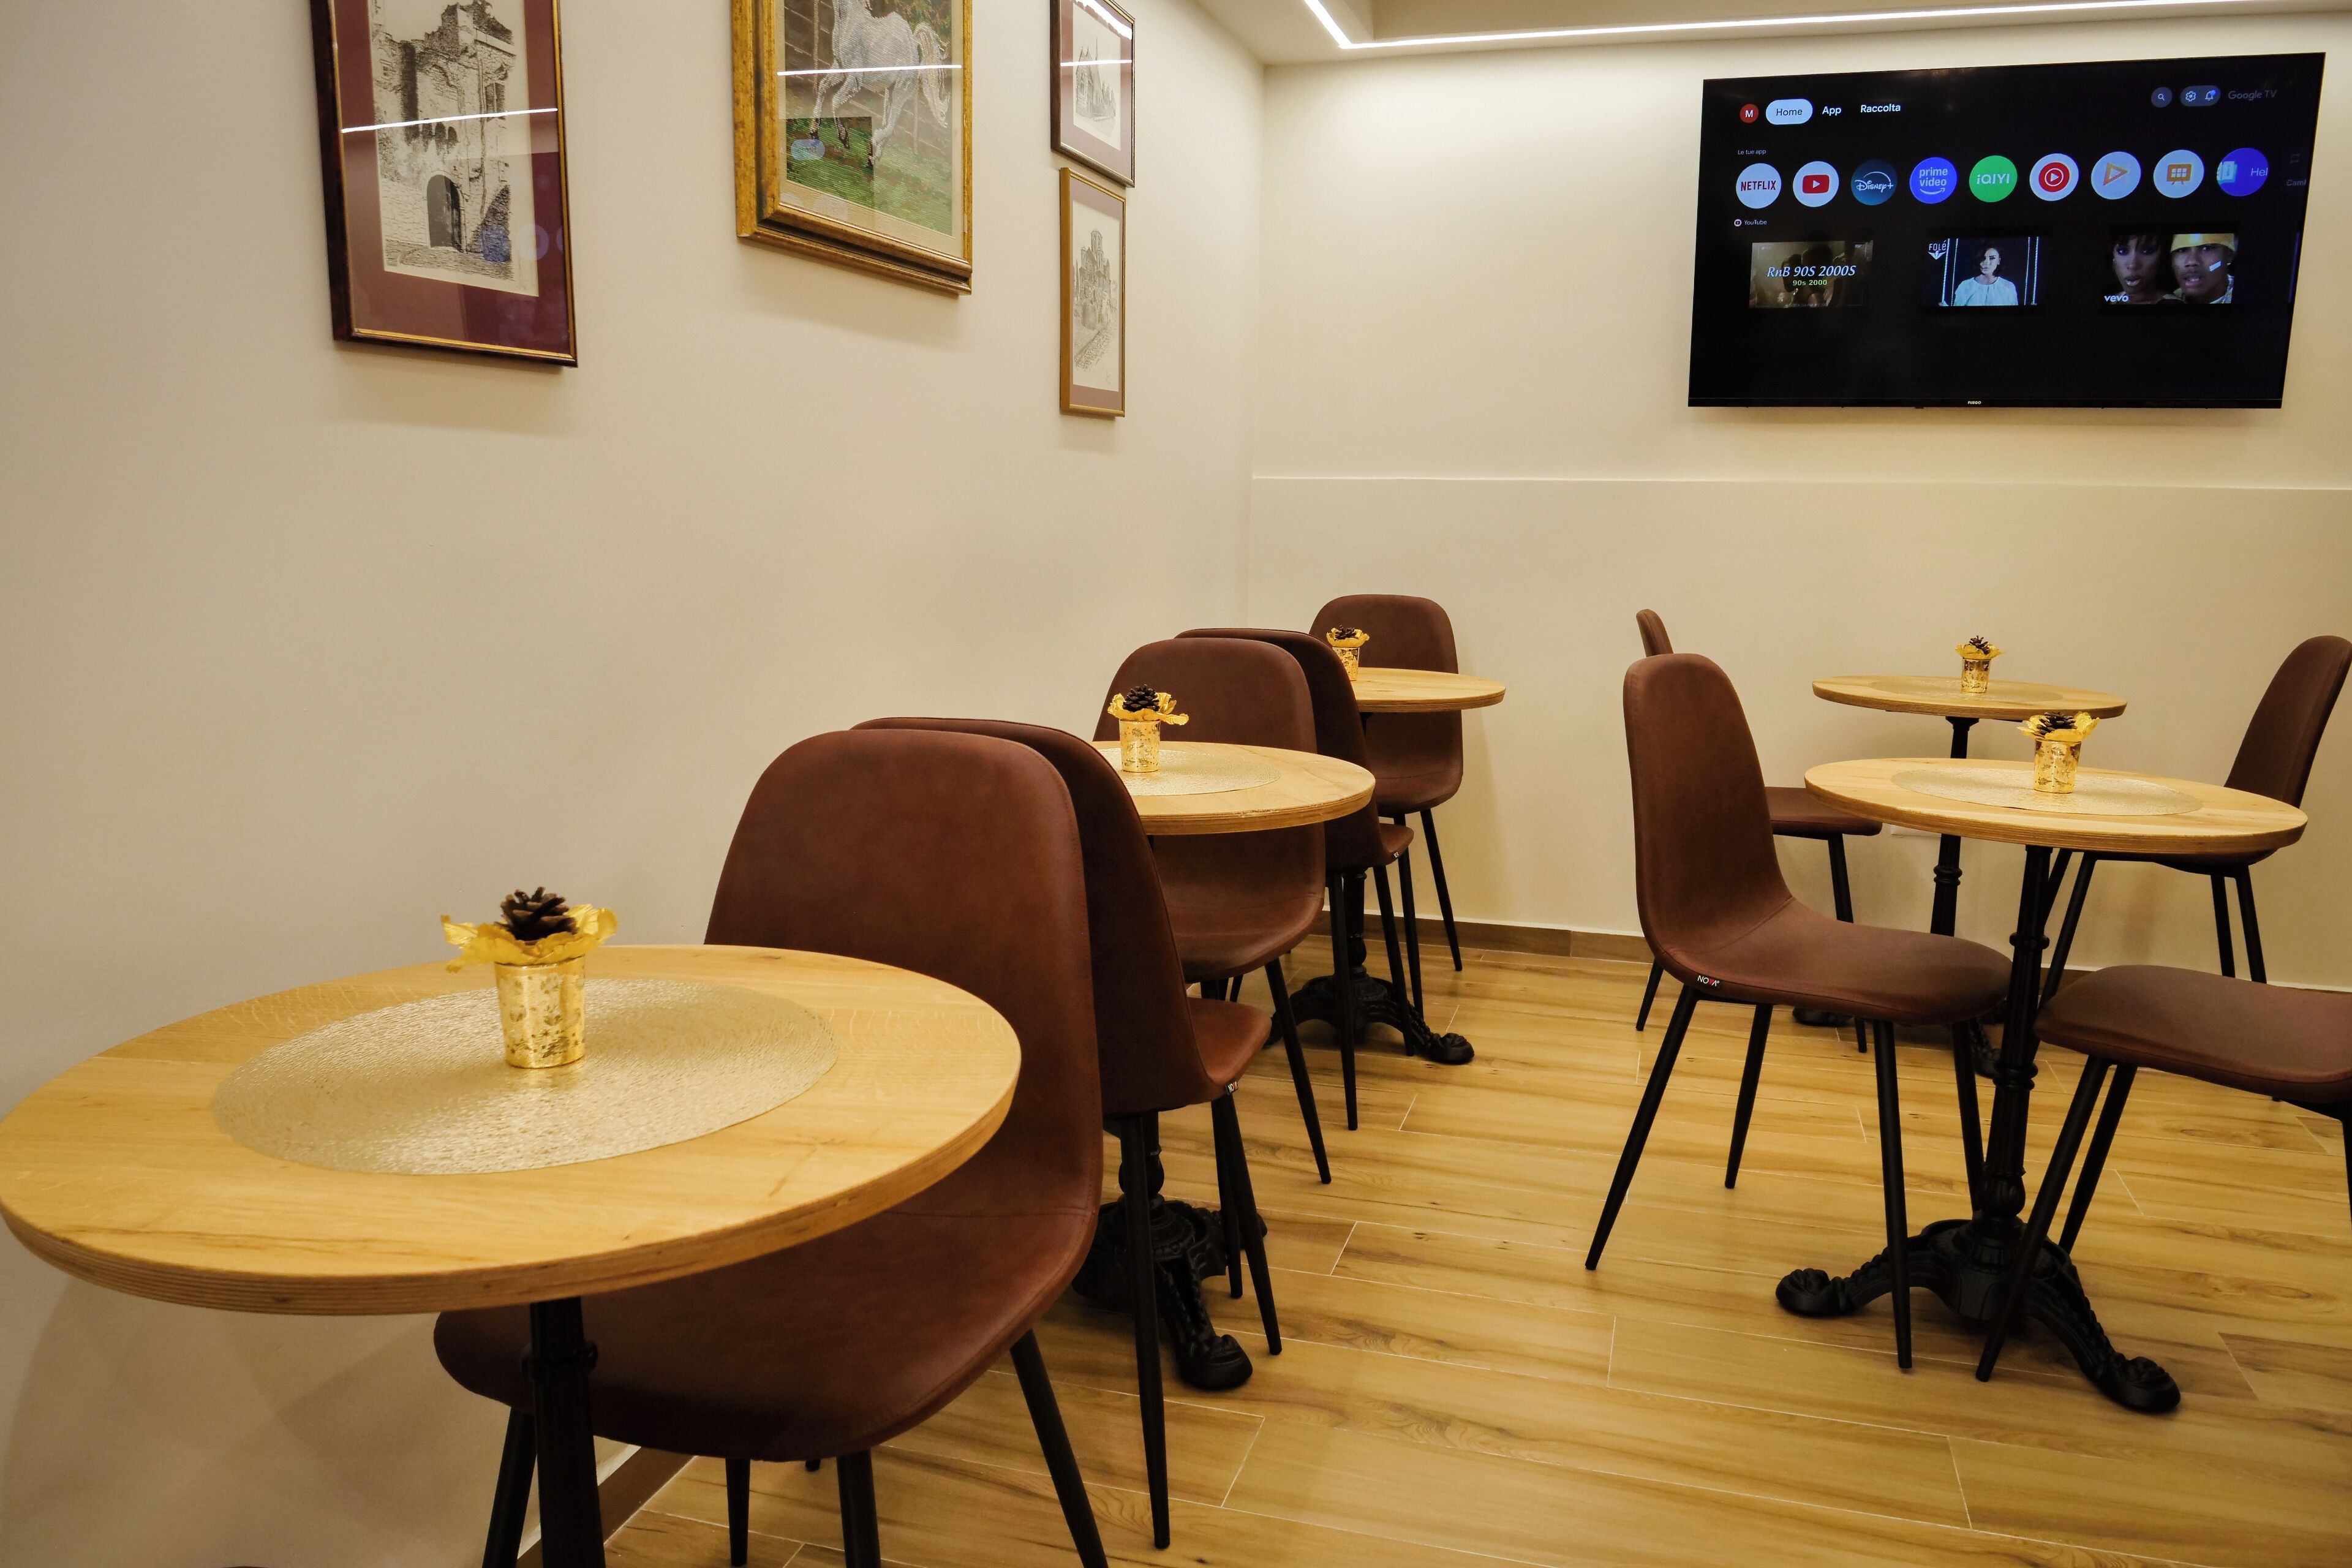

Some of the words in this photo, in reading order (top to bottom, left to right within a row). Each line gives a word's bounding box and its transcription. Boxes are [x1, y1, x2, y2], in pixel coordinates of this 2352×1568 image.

[2228, 90, 2263, 102] Google
[1776, 108, 1803, 116] Home
[1822, 106, 1842, 116] App
[1860, 103, 1901, 113] Raccolta
[1745, 109, 1754, 118] M
[1920, 167, 1948, 178] prime
[1741, 180, 1776, 192] NETFLIX
[1920, 177, 1947, 187] video
[1767, 266, 1790, 277] RnB
[1793, 266, 1816, 277] 90S
[1818, 265, 1856, 277] 2000S
